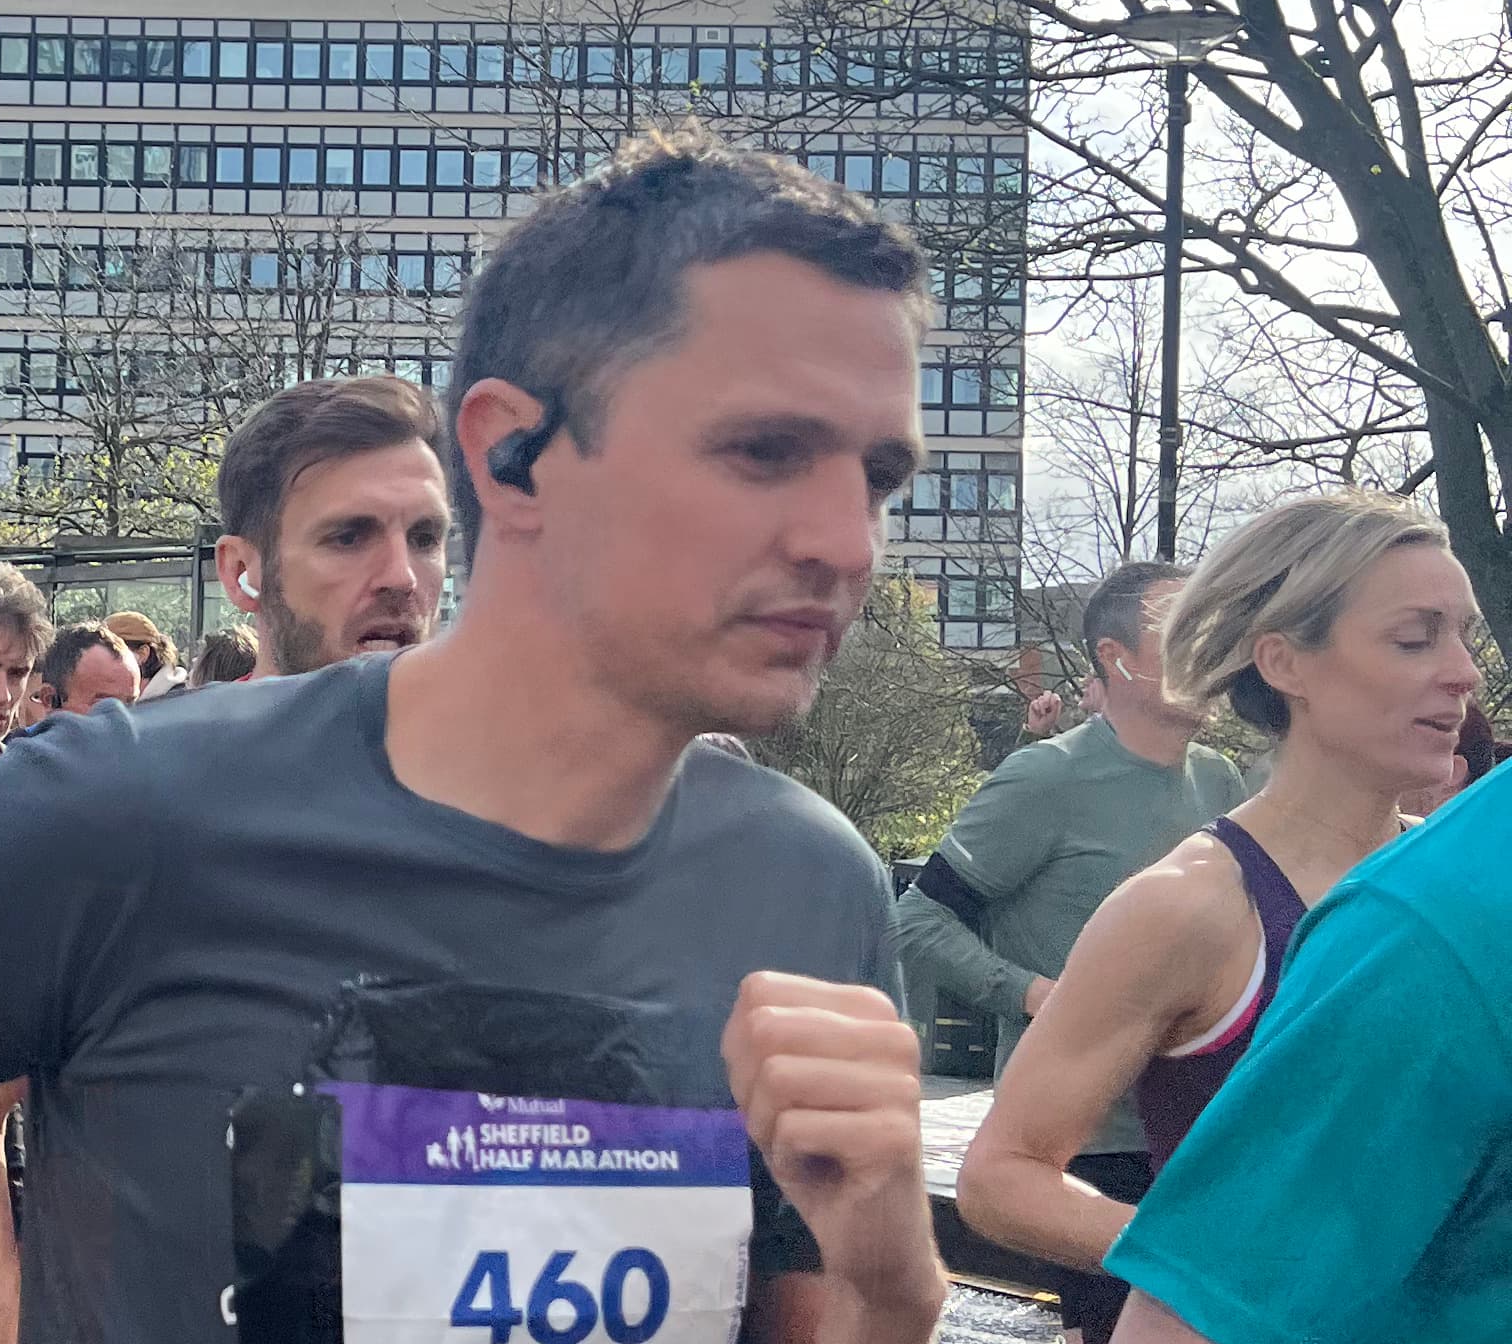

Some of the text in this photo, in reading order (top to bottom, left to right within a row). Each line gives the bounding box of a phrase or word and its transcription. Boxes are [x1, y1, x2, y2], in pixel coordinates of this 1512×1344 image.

[507, 1096, 566, 1114] Mutual
[480, 1123, 590, 1146] SHEFFIELD
[480, 1149, 679, 1170] HALF MARATHON
